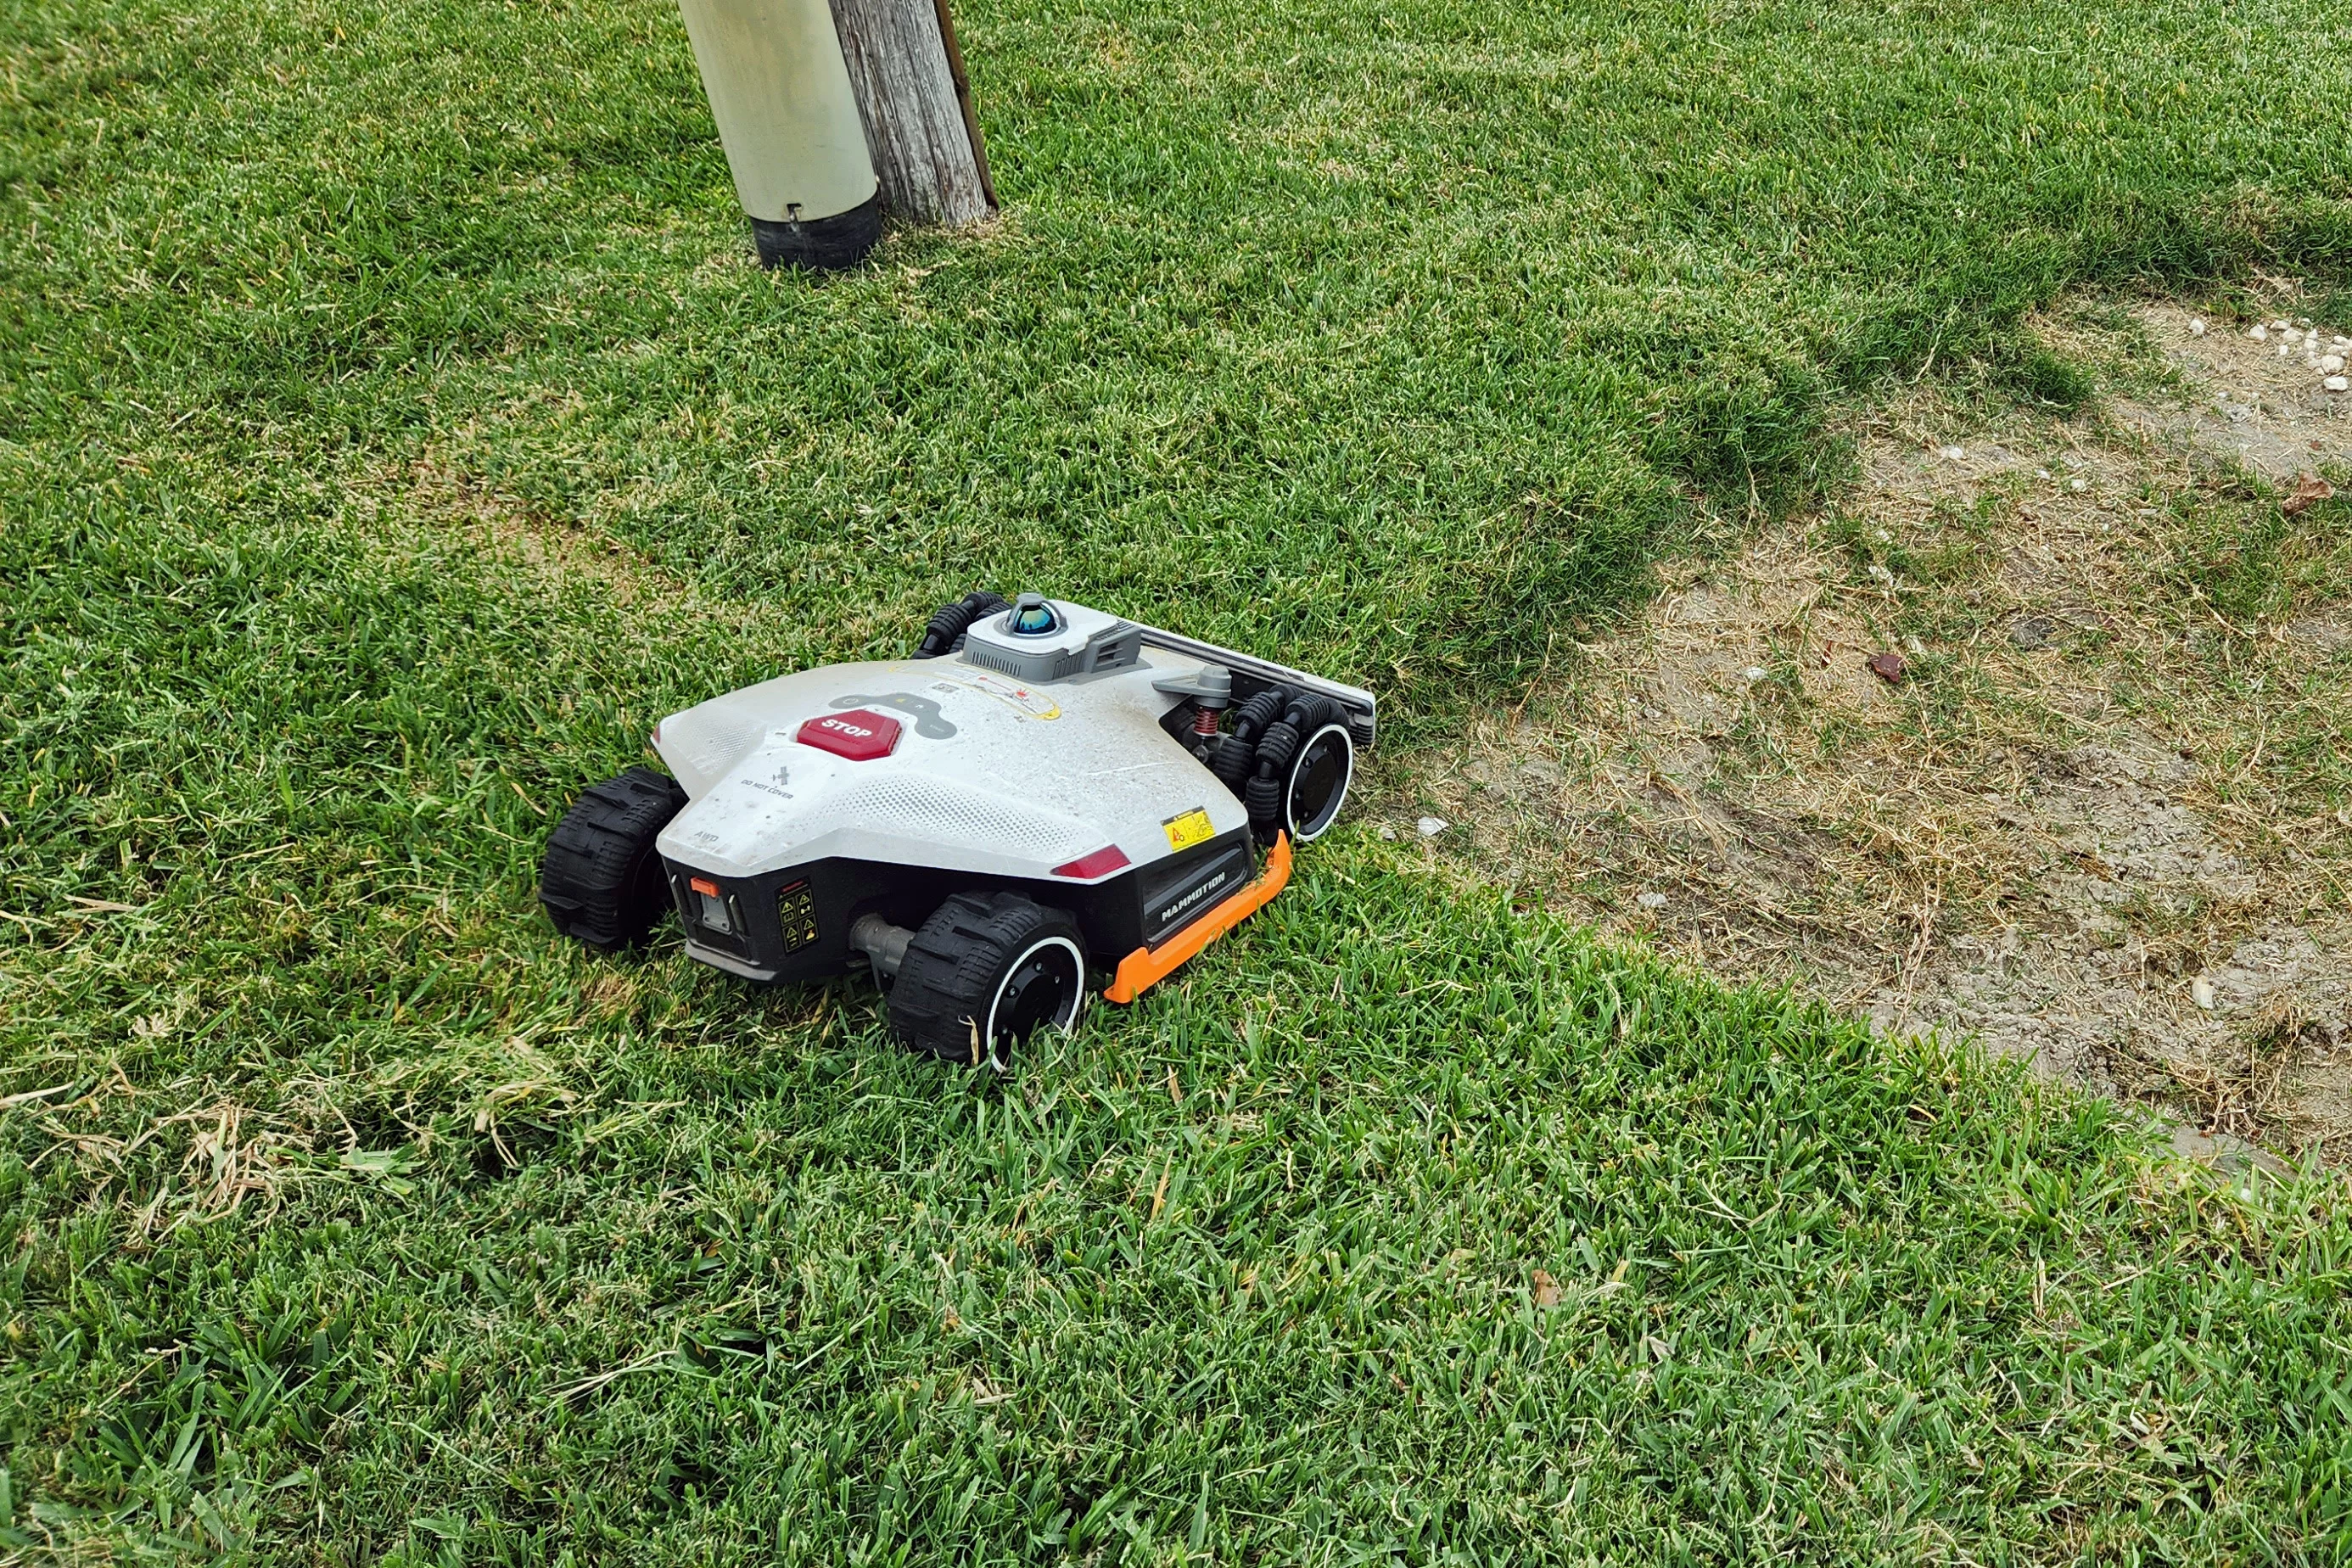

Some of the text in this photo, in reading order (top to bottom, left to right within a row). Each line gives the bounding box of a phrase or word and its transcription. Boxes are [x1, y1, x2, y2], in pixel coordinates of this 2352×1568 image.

[821, 719, 872, 737] STOP
[753, 782, 770, 791] NOT
[767, 787, 794, 799] COVER
[693, 831, 720, 842] AWD
[1162, 871, 1225, 922] MAMMOTION
